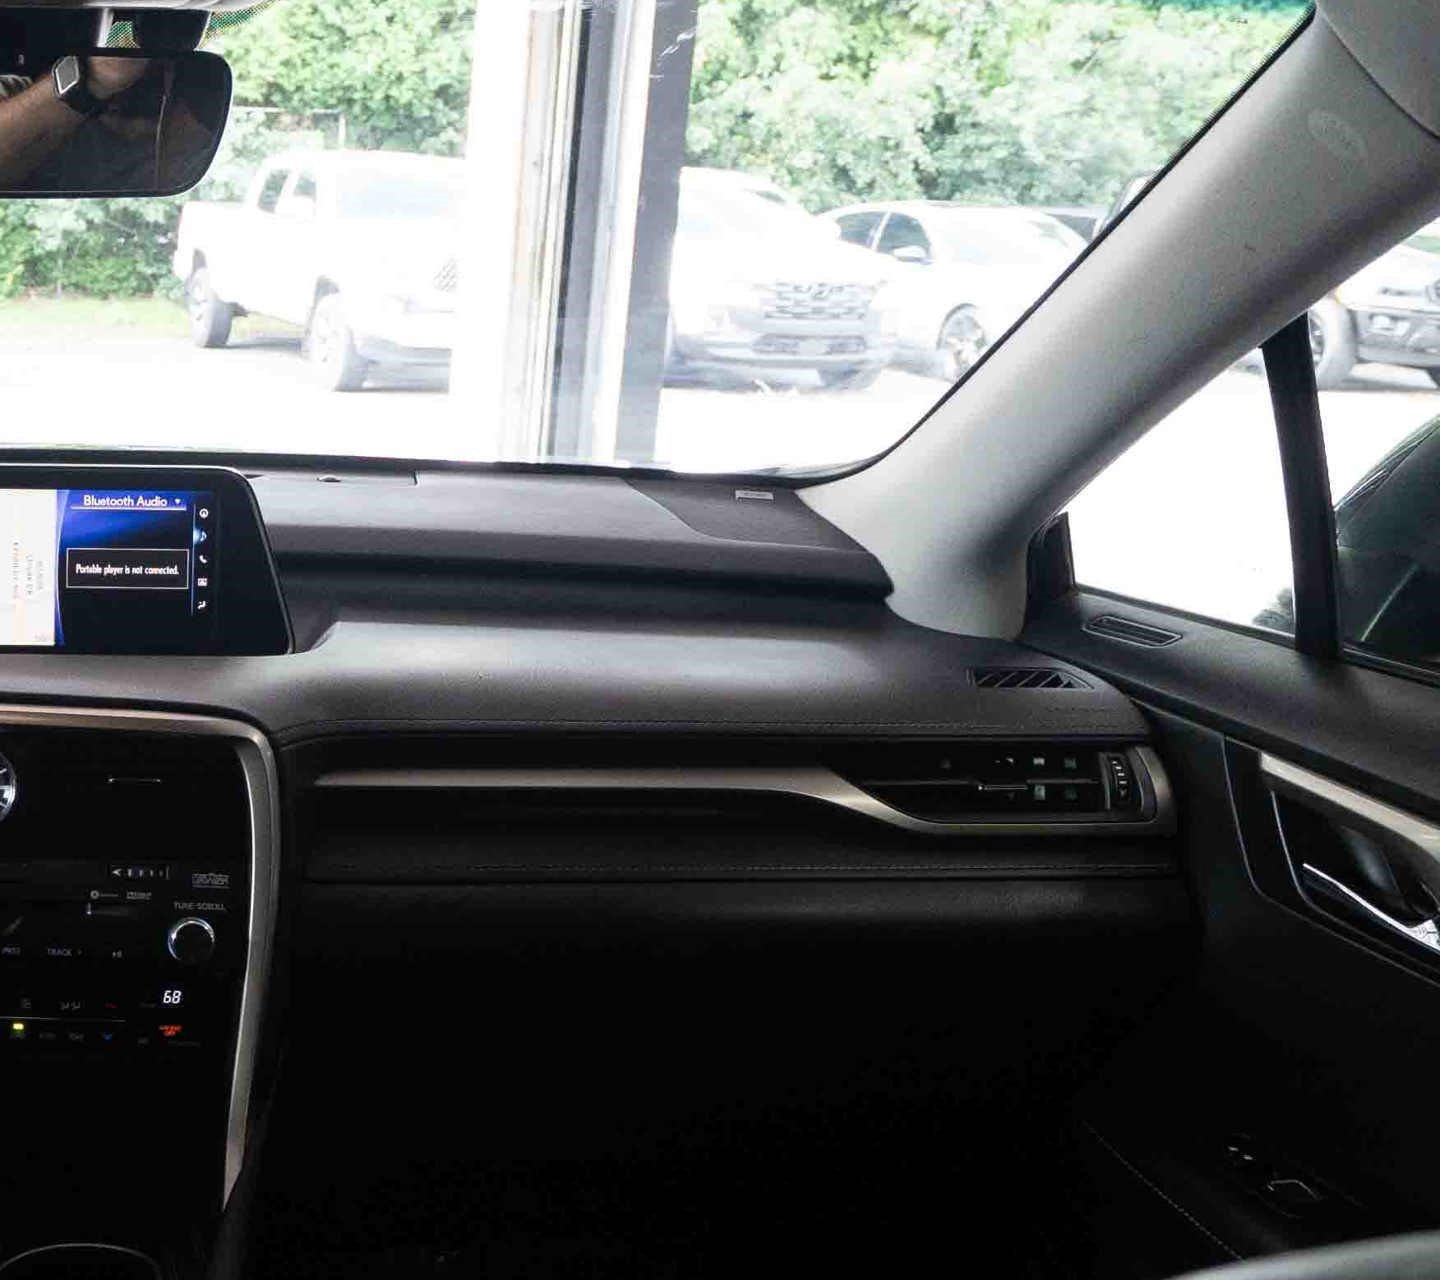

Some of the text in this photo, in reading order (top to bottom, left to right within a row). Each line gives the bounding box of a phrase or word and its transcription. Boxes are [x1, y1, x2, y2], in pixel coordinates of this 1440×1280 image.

[83, 494, 168, 507] Bluetooth Audio
[75, 563, 180, 577] Portable player is not connected.
[163, 989, 182, 1005] 68
